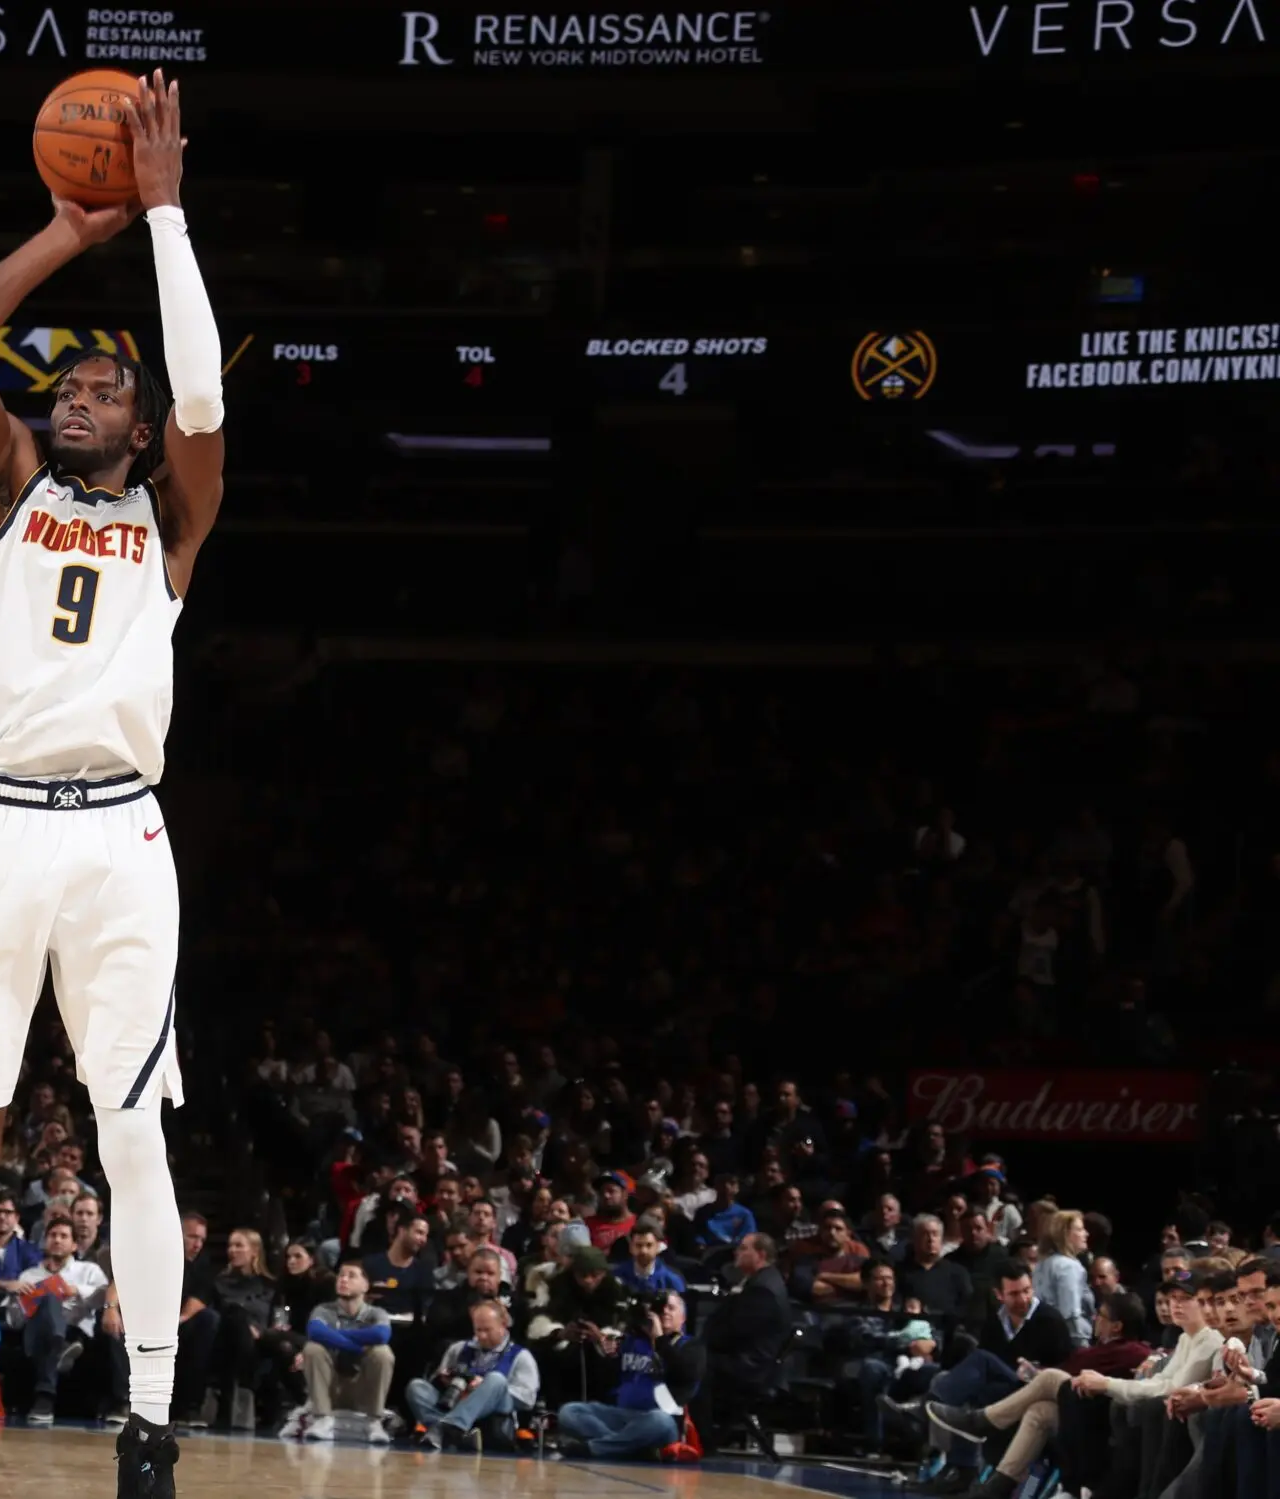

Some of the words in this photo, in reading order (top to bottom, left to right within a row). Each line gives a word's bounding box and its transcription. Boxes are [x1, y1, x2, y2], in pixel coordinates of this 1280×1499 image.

[89, 10, 174, 26] ROOFTOP
[972, 0, 1265, 56] VERSA
[85, 26, 203, 44] RESTAURANT
[399, 12, 453, 65] R
[476, 13, 756, 45] RENAISSANCE
[84, 44, 207, 62] EXPERIENCES
[473, 50, 521, 66] NEW
[528, 49, 584, 65] YORK
[590, 48, 689, 65] MIDTOWN
[695, 47, 763, 64] HOTEL
[59, 103, 128, 125] SPALD
[588, 340, 690, 356] BLOCKED
[695, 339, 767, 355] SHOTS
[1081, 331, 1129, 357] LIKE
[1137, 329, 1177, 354] THE
[1184, 324, 1280, 352] KNICKS!
[275, 345, 338, 361] FOULS
[458, 347, 496, 363] TOL
[299, 362, 312, 385] 3
[660, 364, 688, 396] 4
[22, 510, 148, 564] NUGGETS
[51, 563, 102, 646] 9
[912, 1073, 1198, 1133] Budweiser
